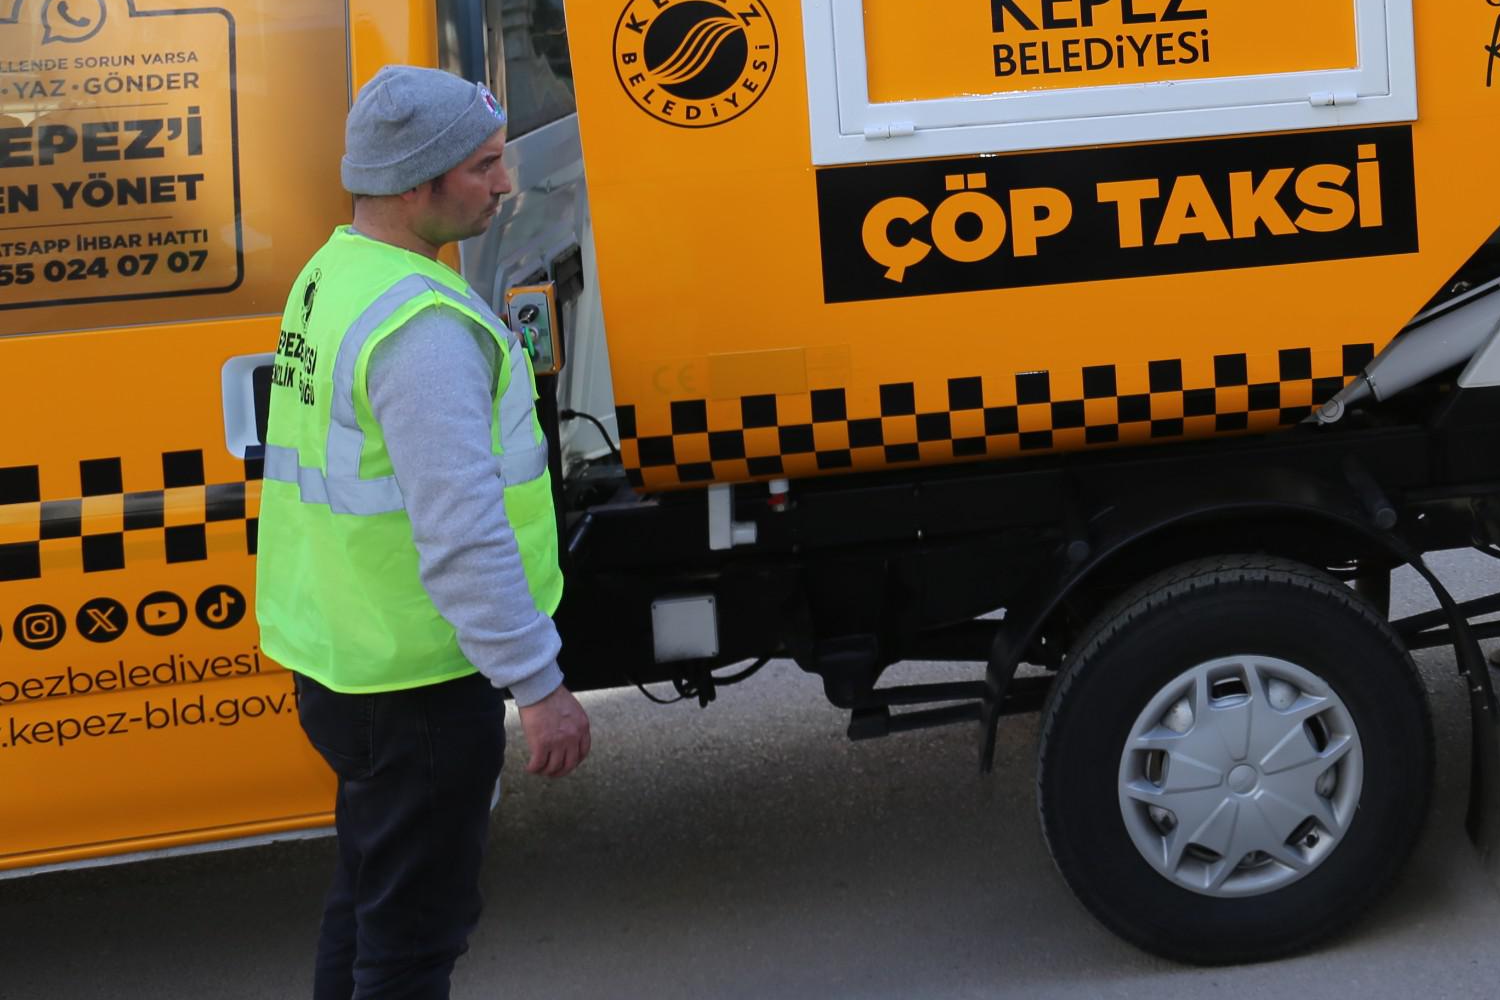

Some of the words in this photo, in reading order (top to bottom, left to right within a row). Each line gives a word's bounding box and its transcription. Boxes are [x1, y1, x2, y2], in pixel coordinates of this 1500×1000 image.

[74, 54, 135, 69] SORUN
[141, 51, 198, 65] VARSA
[13, 79, 66, 99] YAZ
[83, 71, 199, 95] GÖNDER
[52, 172, 204, 210] YÖNET
[861, 172, 1073, 284] ÇÖP
[1096, 143, 1383, 248] TAKSİ
[0, 239, 70, 257] TSAPP
[76, 233, 143, 251] İHBAR
[148, 228, 208, 246] HATTI
[43, 257, 109, 282] 024
[117, 253, 159, 276] 07
[167, 250, 209, 273] 07
